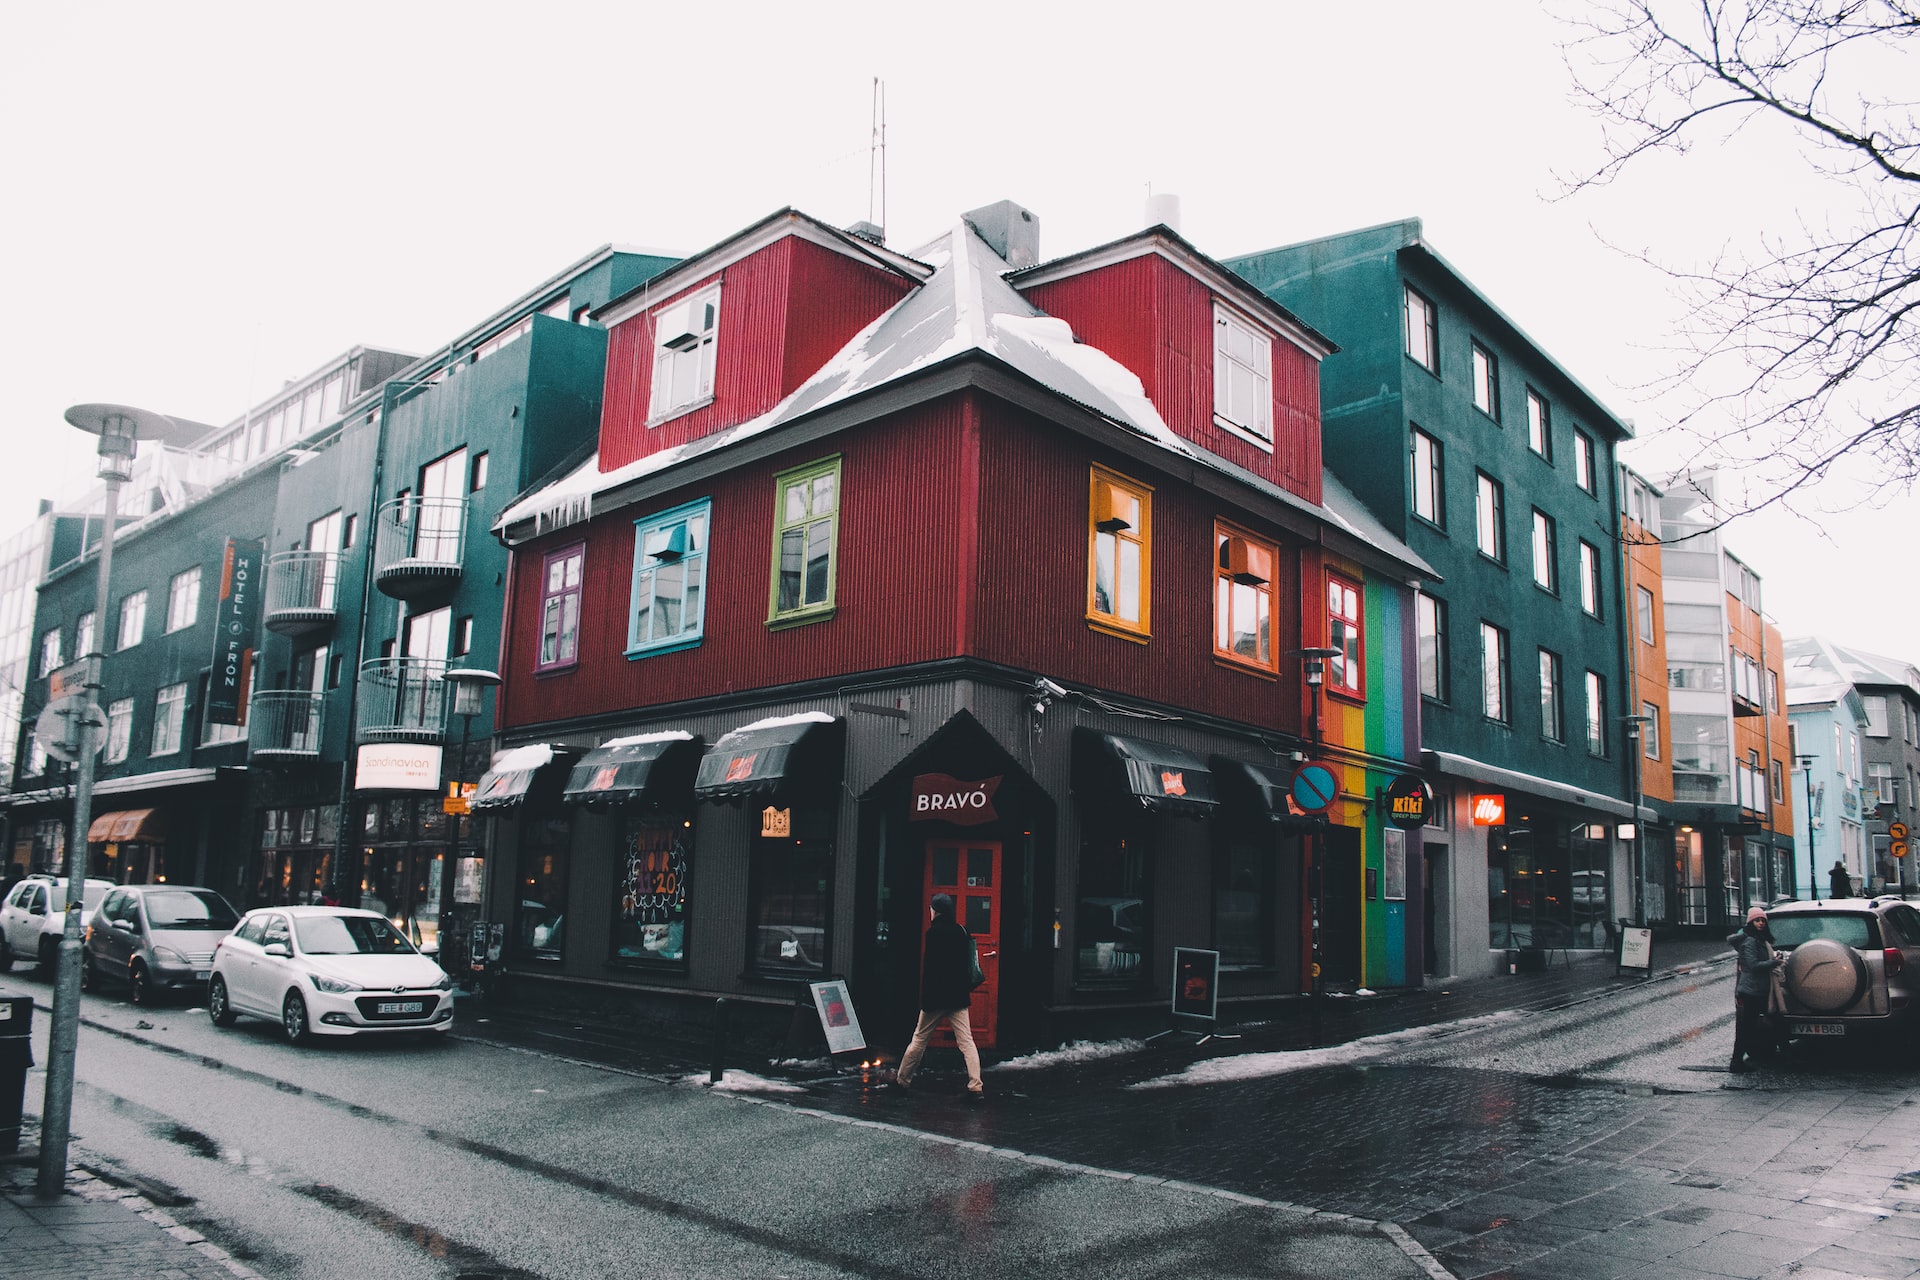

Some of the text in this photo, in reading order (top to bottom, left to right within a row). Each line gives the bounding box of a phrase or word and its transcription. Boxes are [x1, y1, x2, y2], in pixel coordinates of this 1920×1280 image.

[365, 756, 429, 769] Scandinavian
[916, 783, 987, 811] BRAVÓ
[1392, 796, 1424, 814] Kiki
[1474, 798, 1502, 823] illy
[640, 851, 670, 872] HOUR
